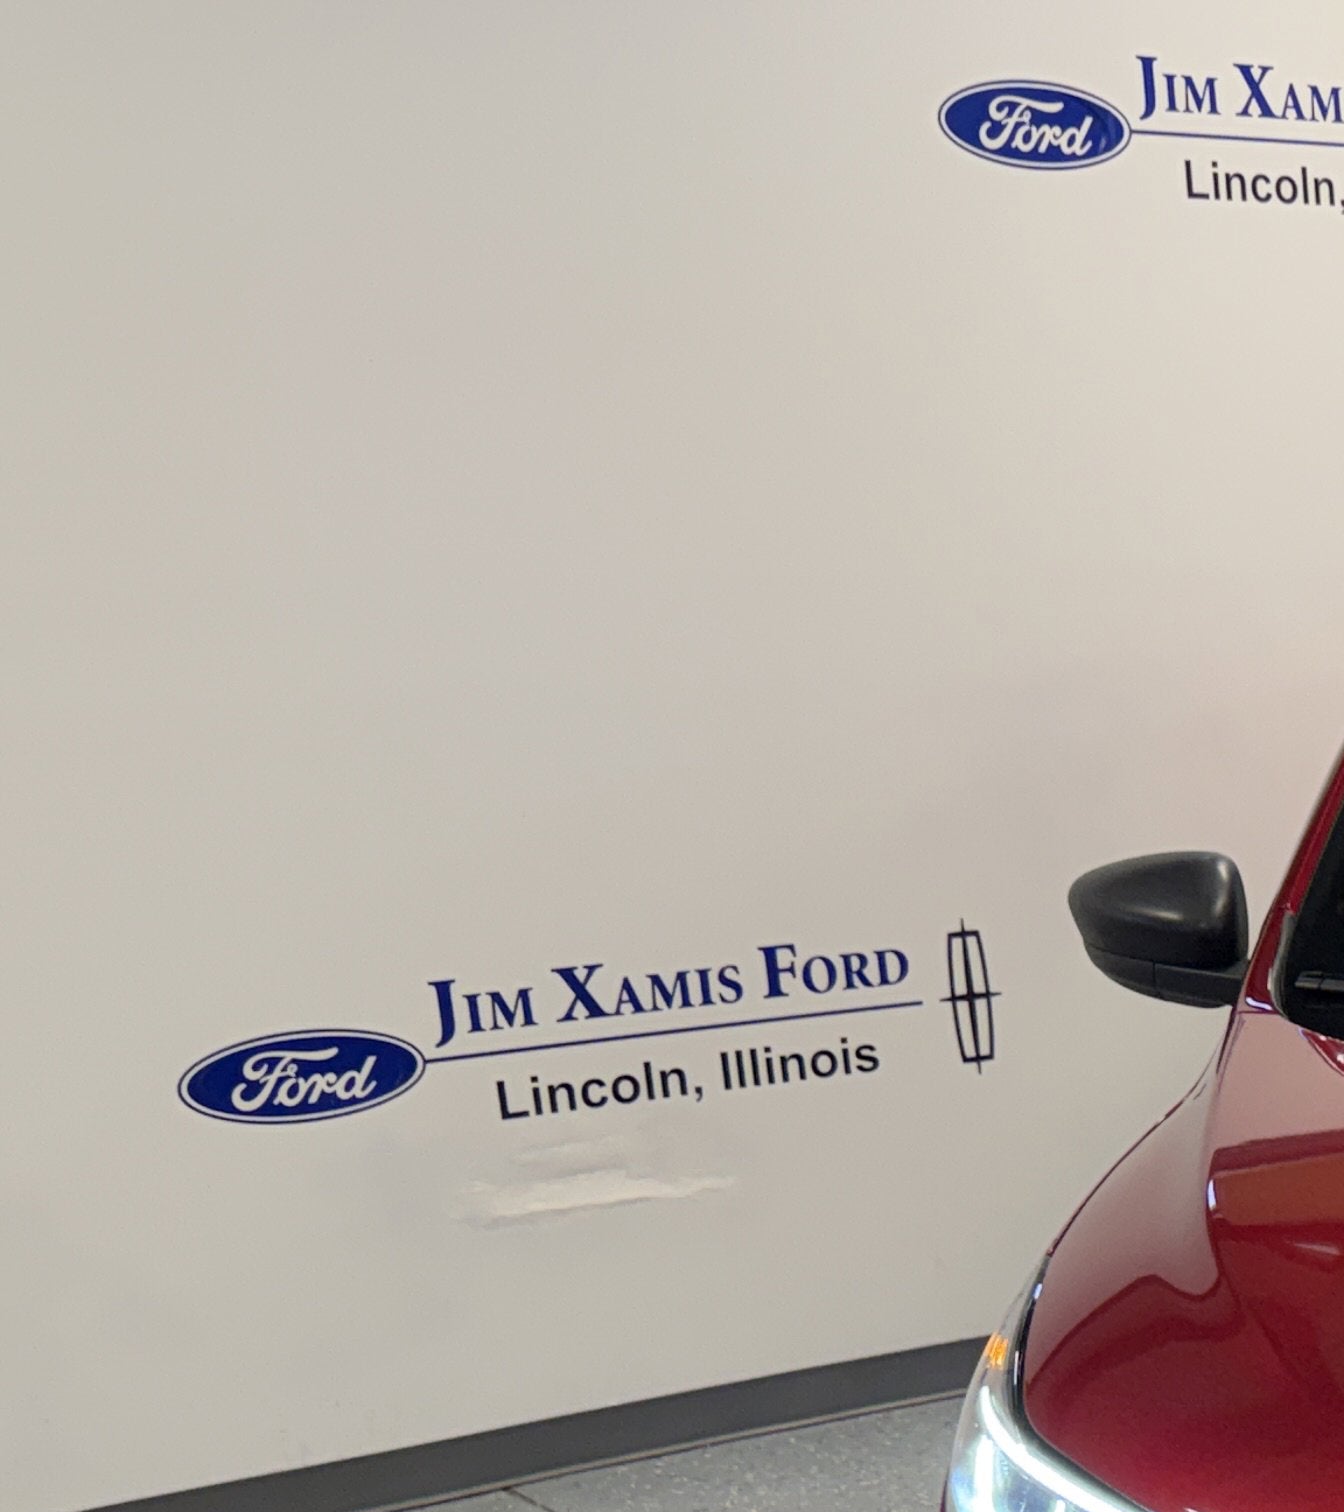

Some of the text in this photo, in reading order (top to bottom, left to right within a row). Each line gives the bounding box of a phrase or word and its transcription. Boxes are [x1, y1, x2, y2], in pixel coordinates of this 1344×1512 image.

[1135, 55, 1221, 121] JIM
[978, 94, 1093, 157] Ford
[427, 943, 909, 1049] JIM XAMIS FORD
[231, 1046, 377, 1112] Ford
[496, 1037, 880, 1121] Lincoln, Illinois
